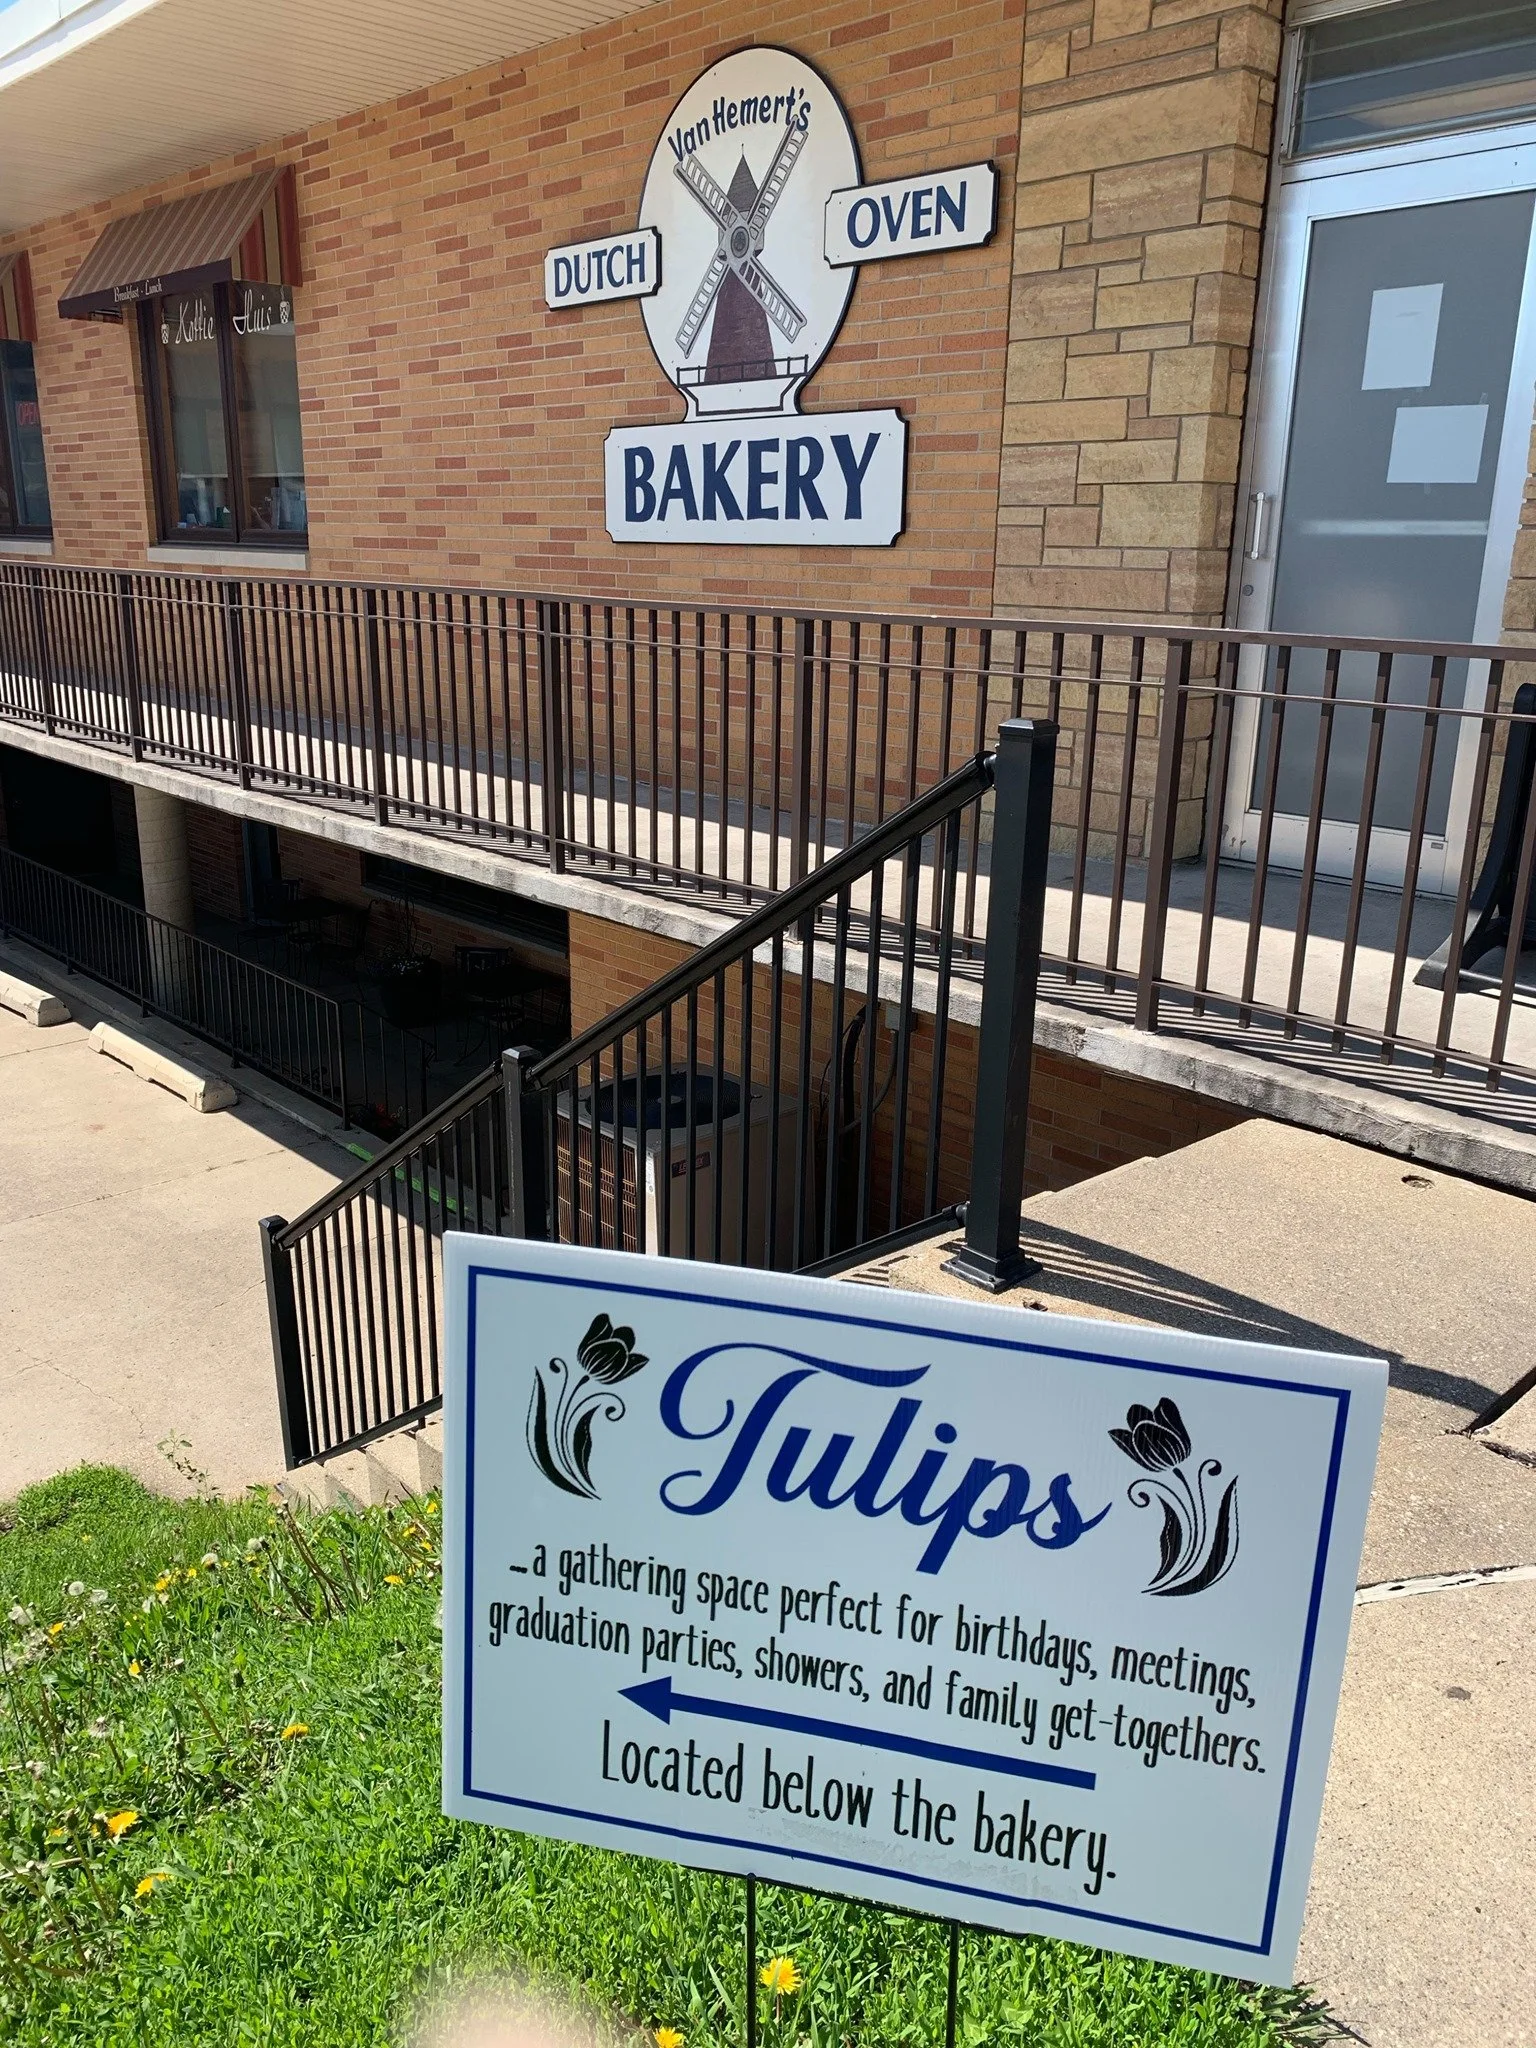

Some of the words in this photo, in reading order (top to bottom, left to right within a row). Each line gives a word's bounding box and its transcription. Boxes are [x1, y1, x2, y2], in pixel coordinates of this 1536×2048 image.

[668, 117, 711, 162] Van
[712, 86, 811, 136] Hemert's
[847, 180, 968, 249] OVEN
[553, 240, 646, 298] DUTCH
[175, 298, 215, 344] Koffie
[232, 289, 272, 335] Huis
[624, 432, 882, 523] BAKERY
[659, 1342, 1113, 1576] Tulips
[559, 1543, 687, 1615] gathering
[696, 1571, 770, 1622] space
[780, 1580, 883, 1635] perfect
[896, 1593, 943, 1645] for
[955, 1604, 1098, 1687] birthdays,
[1111, 1645, 1256, 1715] meetings,
[488, 1596, 630, 1655] graduation
[642, 1624, 743, 1679] parties,
[754, 1636, 870, 1703] showers,
[883, 1665, 933, 1710] and
[945, 1669, 1038, 1746] family
[1048, 1699, 1266, 1774] get-togethers.
[601, 1718, 744, 1803] Located
[762, 1747, 873, 1828] below
[892, 1777, 957, 1846] the
[973, 1789, 1117, 1896] bakery.
